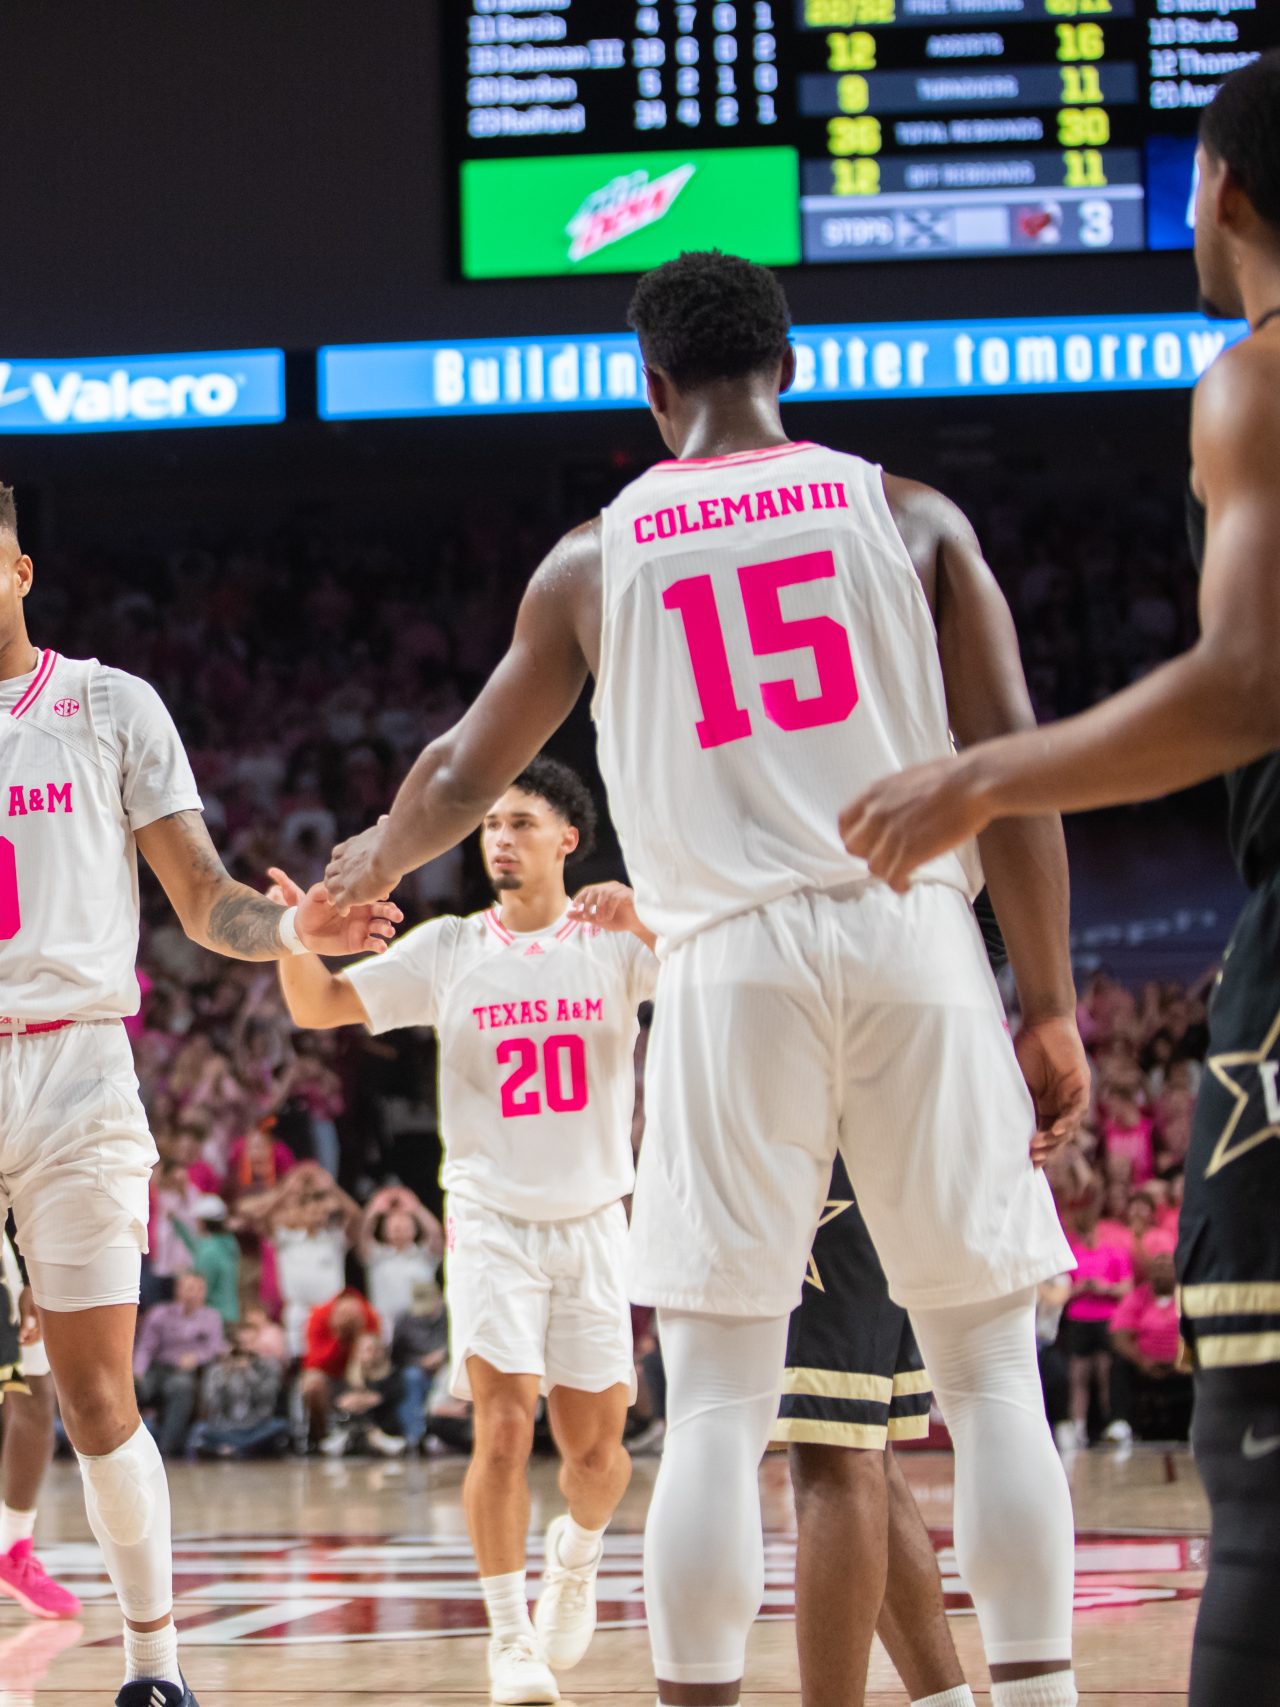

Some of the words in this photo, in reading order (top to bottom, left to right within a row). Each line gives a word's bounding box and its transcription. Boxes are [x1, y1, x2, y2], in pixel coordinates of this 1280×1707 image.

[675, 5, 697, 34] 7
[712, 3, 737, 32] 0
[754, 1, 774, 30] 1
[753, 32, 776, 62] 2
[826, 31, 876, 72] 12
[1055, 22, 1104, 61] 16
[1149, 49, 1178, 77] 12
[676, 66, 700, 96] 2
[716, 65, 737, 94] 1
[1060, 65, 1104, 104] 11
[715, 96, 739, 126] 2
[756, 94, 777, 124] 1
[1056, 107, 1110, 146] 30
[1062, 149, 1108, 188] 11
[433, 343, 646, 407] Buildin
[31, 369, 238, 424] Valero
[634, 484, 805, 544] COLEMAN
[808, 482, 849, 509] III
[662, 550, 859, 750] 15
[55, 699, 79, 717] SEC
[8, 782, 73, 817] A&M
[473, 1000, 548, 1030] TEXAS
[557, 998, 603, 1021] A&M
[496, 1034, 588, 1118] 20
